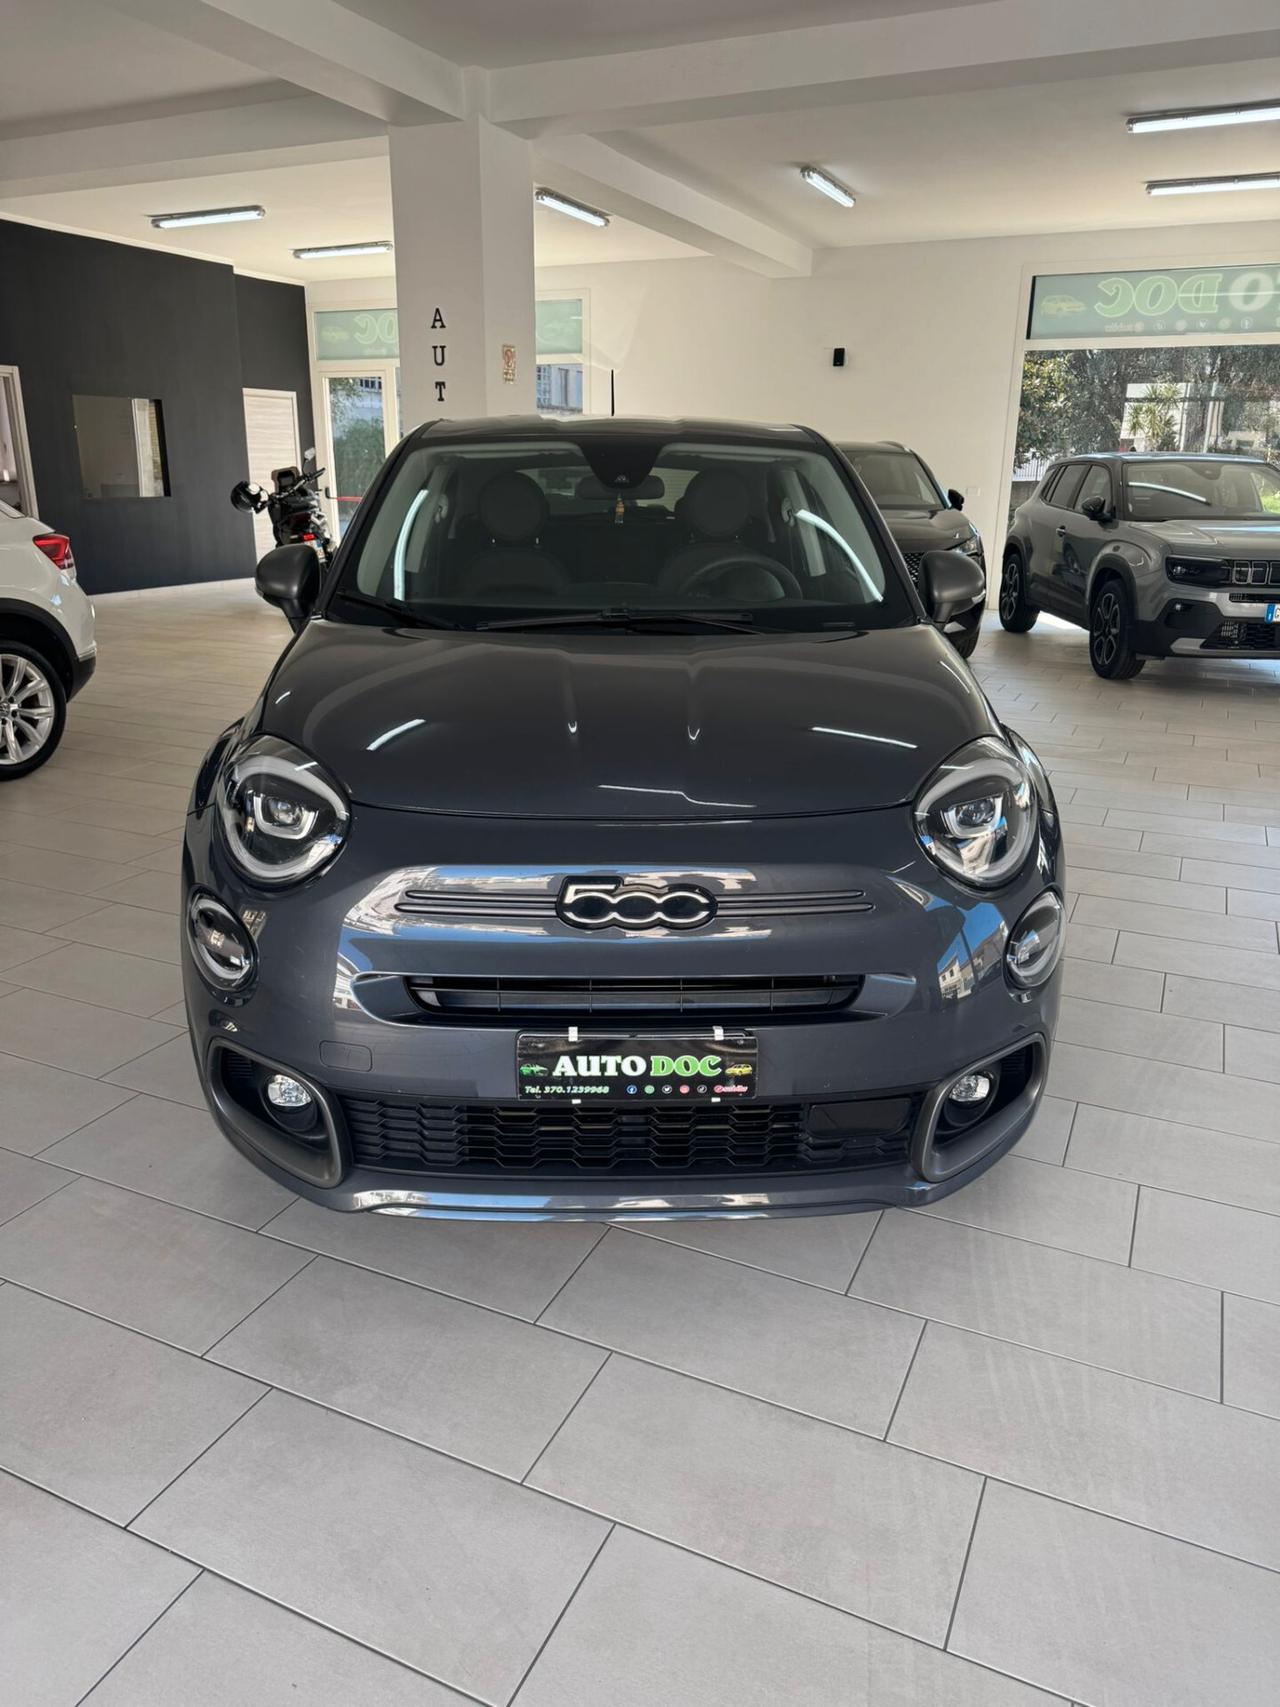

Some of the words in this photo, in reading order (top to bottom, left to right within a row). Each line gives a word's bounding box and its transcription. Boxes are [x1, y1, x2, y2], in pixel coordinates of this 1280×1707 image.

[563, 883, 711, 924] 500
[551, 1055, 647, 1077] AUTO
[650, 1055, 722, 1077] DOC
[524, 1085, 542, 1094] Tel.
